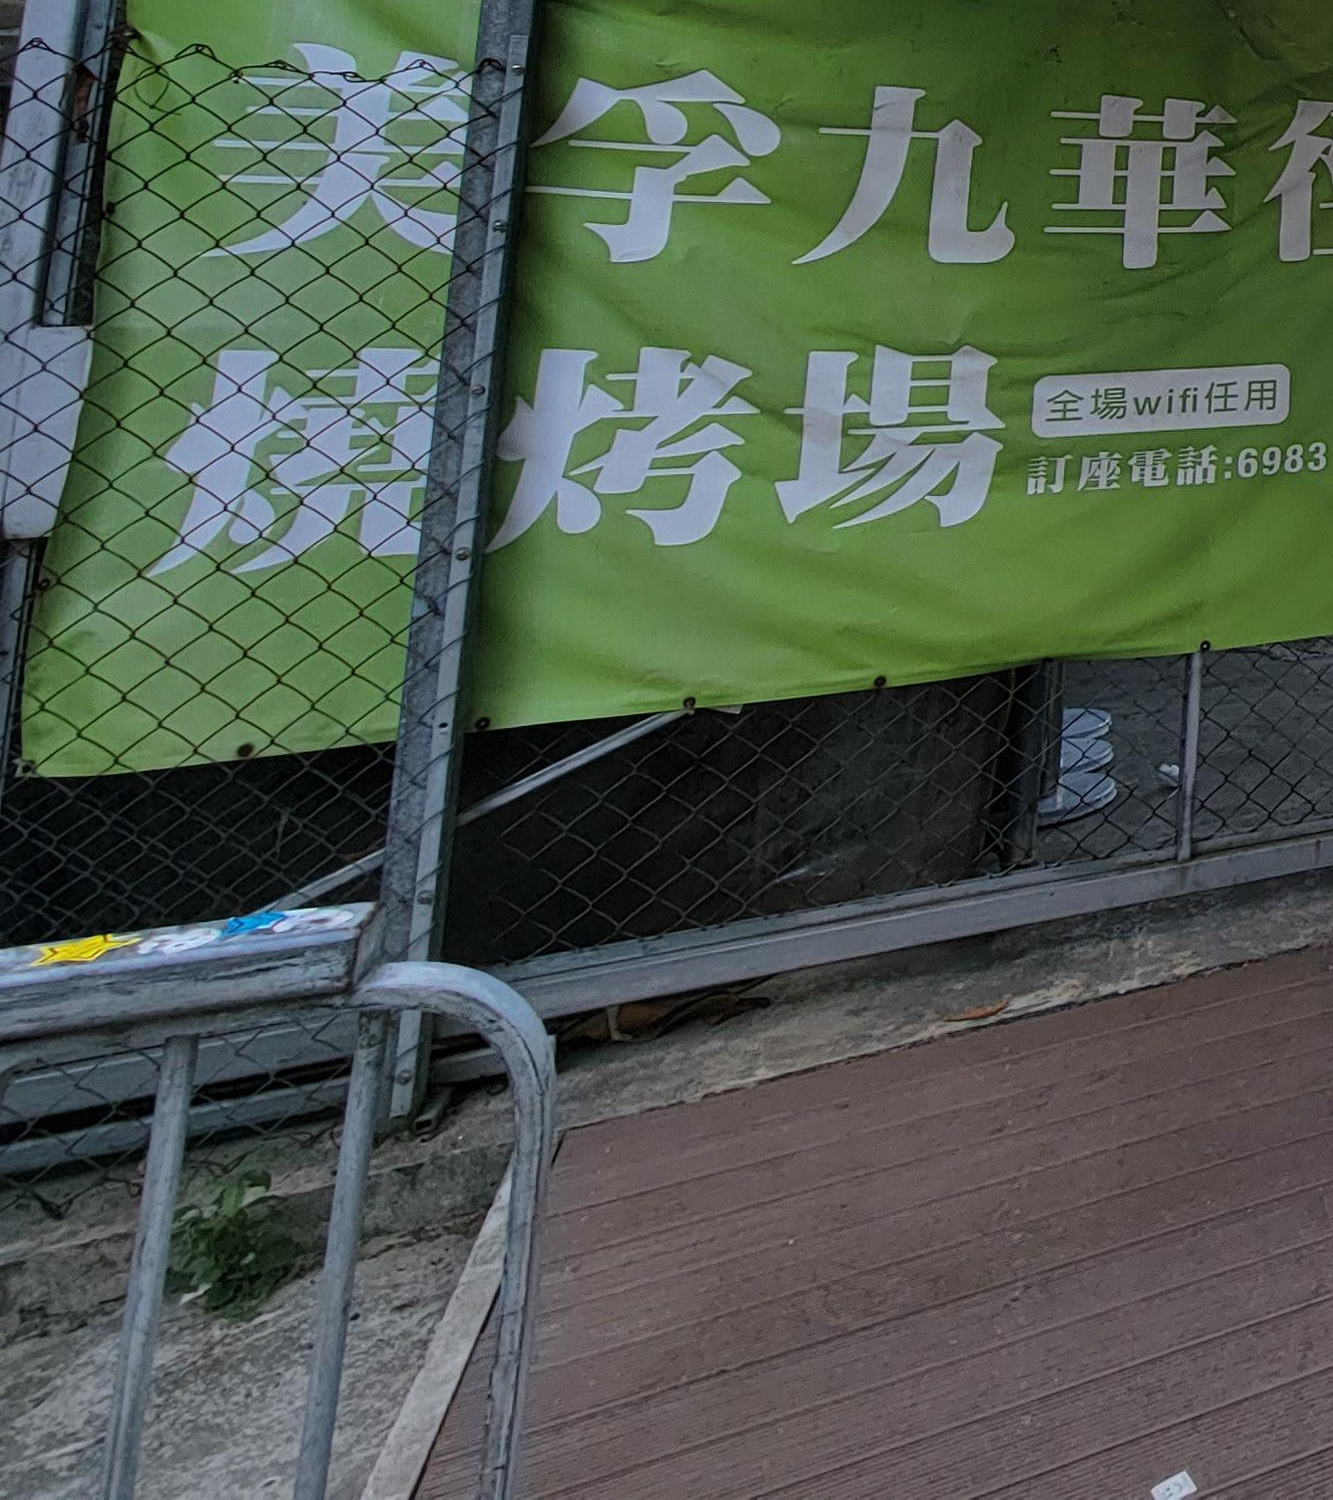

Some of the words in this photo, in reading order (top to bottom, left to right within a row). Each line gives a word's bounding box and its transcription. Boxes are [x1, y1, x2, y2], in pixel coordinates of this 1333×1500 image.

[147, 343, 1006, 577] 燒烤場
[1044, 378, 1279, 423] 全場wifi任用
